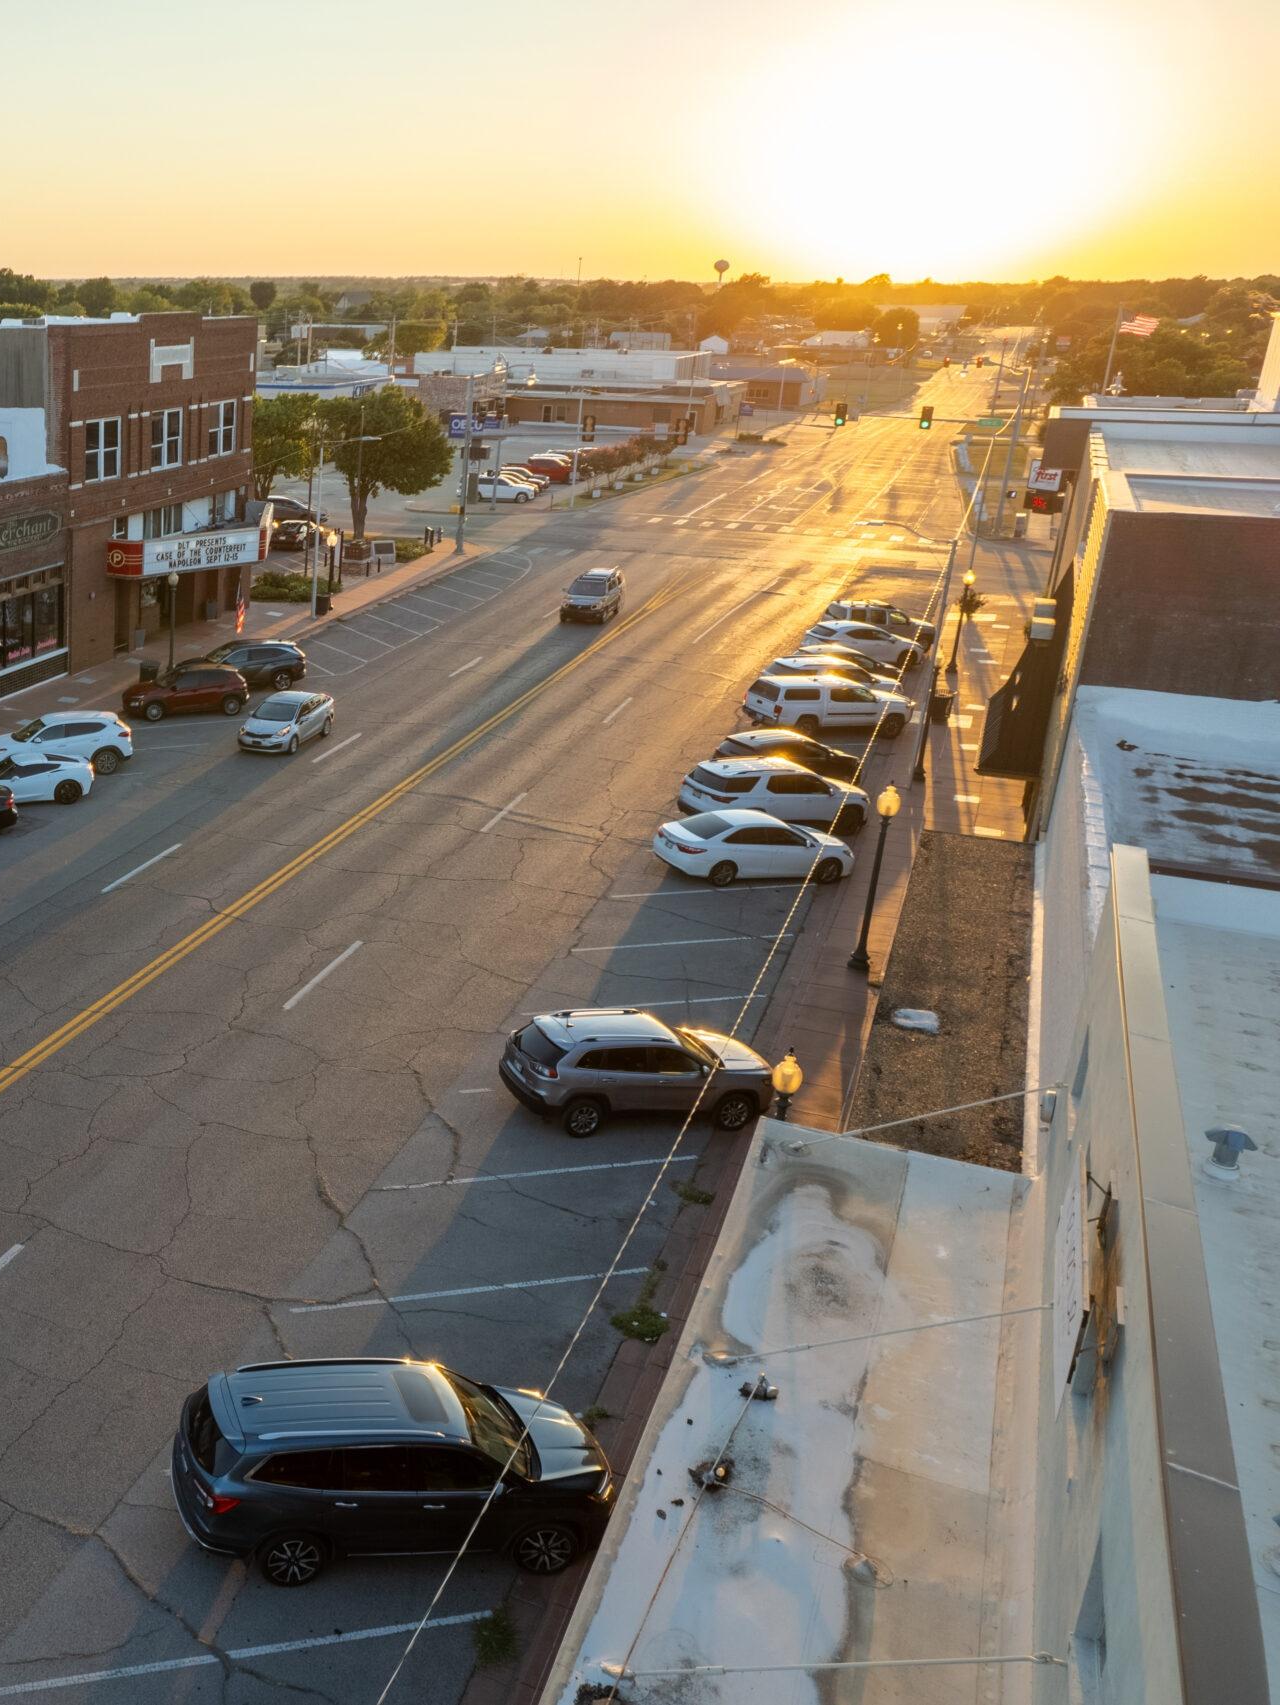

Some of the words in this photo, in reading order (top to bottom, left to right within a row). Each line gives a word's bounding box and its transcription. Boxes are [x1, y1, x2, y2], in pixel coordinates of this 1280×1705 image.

[177, 541, 190, 550] DLT
[195, 537, 227, 547] PRESENTS
[156, 553, 173, 561] CASE
[176, 550, 186, 558] OF
[190, 549, 201, 557] THE
[205, 543, 247, 556] COUNTERFEIT
[168, 558, 202, 569] NAPOLEON
[206, 555, 221, 564] SEPT
[223, 553, 239, 561] 12-15
